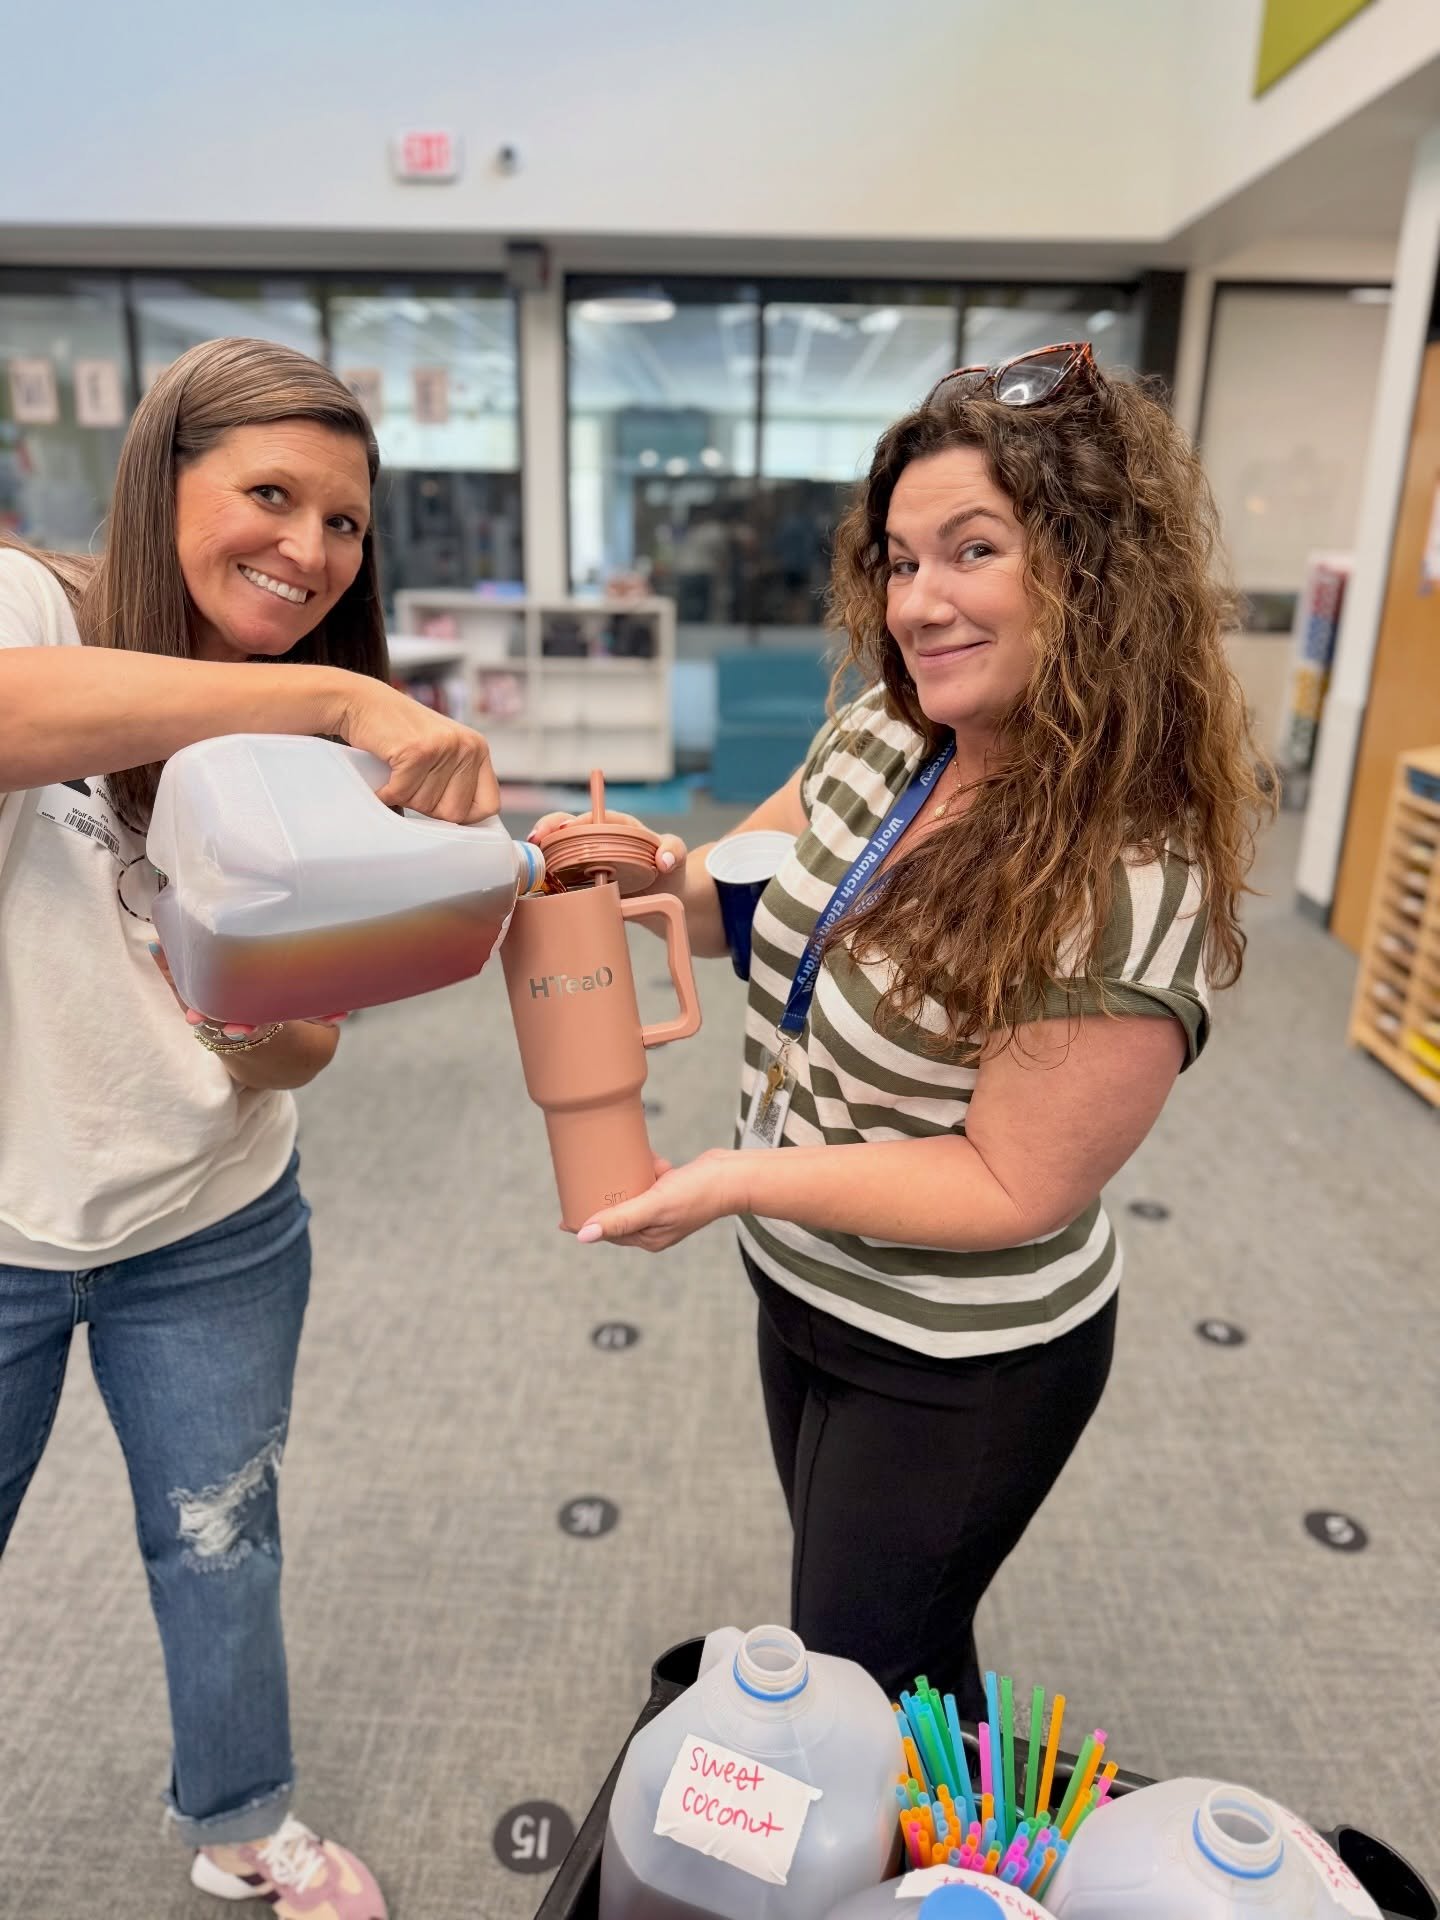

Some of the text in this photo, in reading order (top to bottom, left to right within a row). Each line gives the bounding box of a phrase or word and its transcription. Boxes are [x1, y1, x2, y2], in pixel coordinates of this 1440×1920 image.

[72, 807, 88, 819] Wolf
[872, 817, 905, 852] Wolf
[840, 851, 879, 899] Ranch
[529, 966, 613, 999] HTeaO
[682, 1786, 785, 1838] coconut
[511, 1814, 552, 1860] 15
